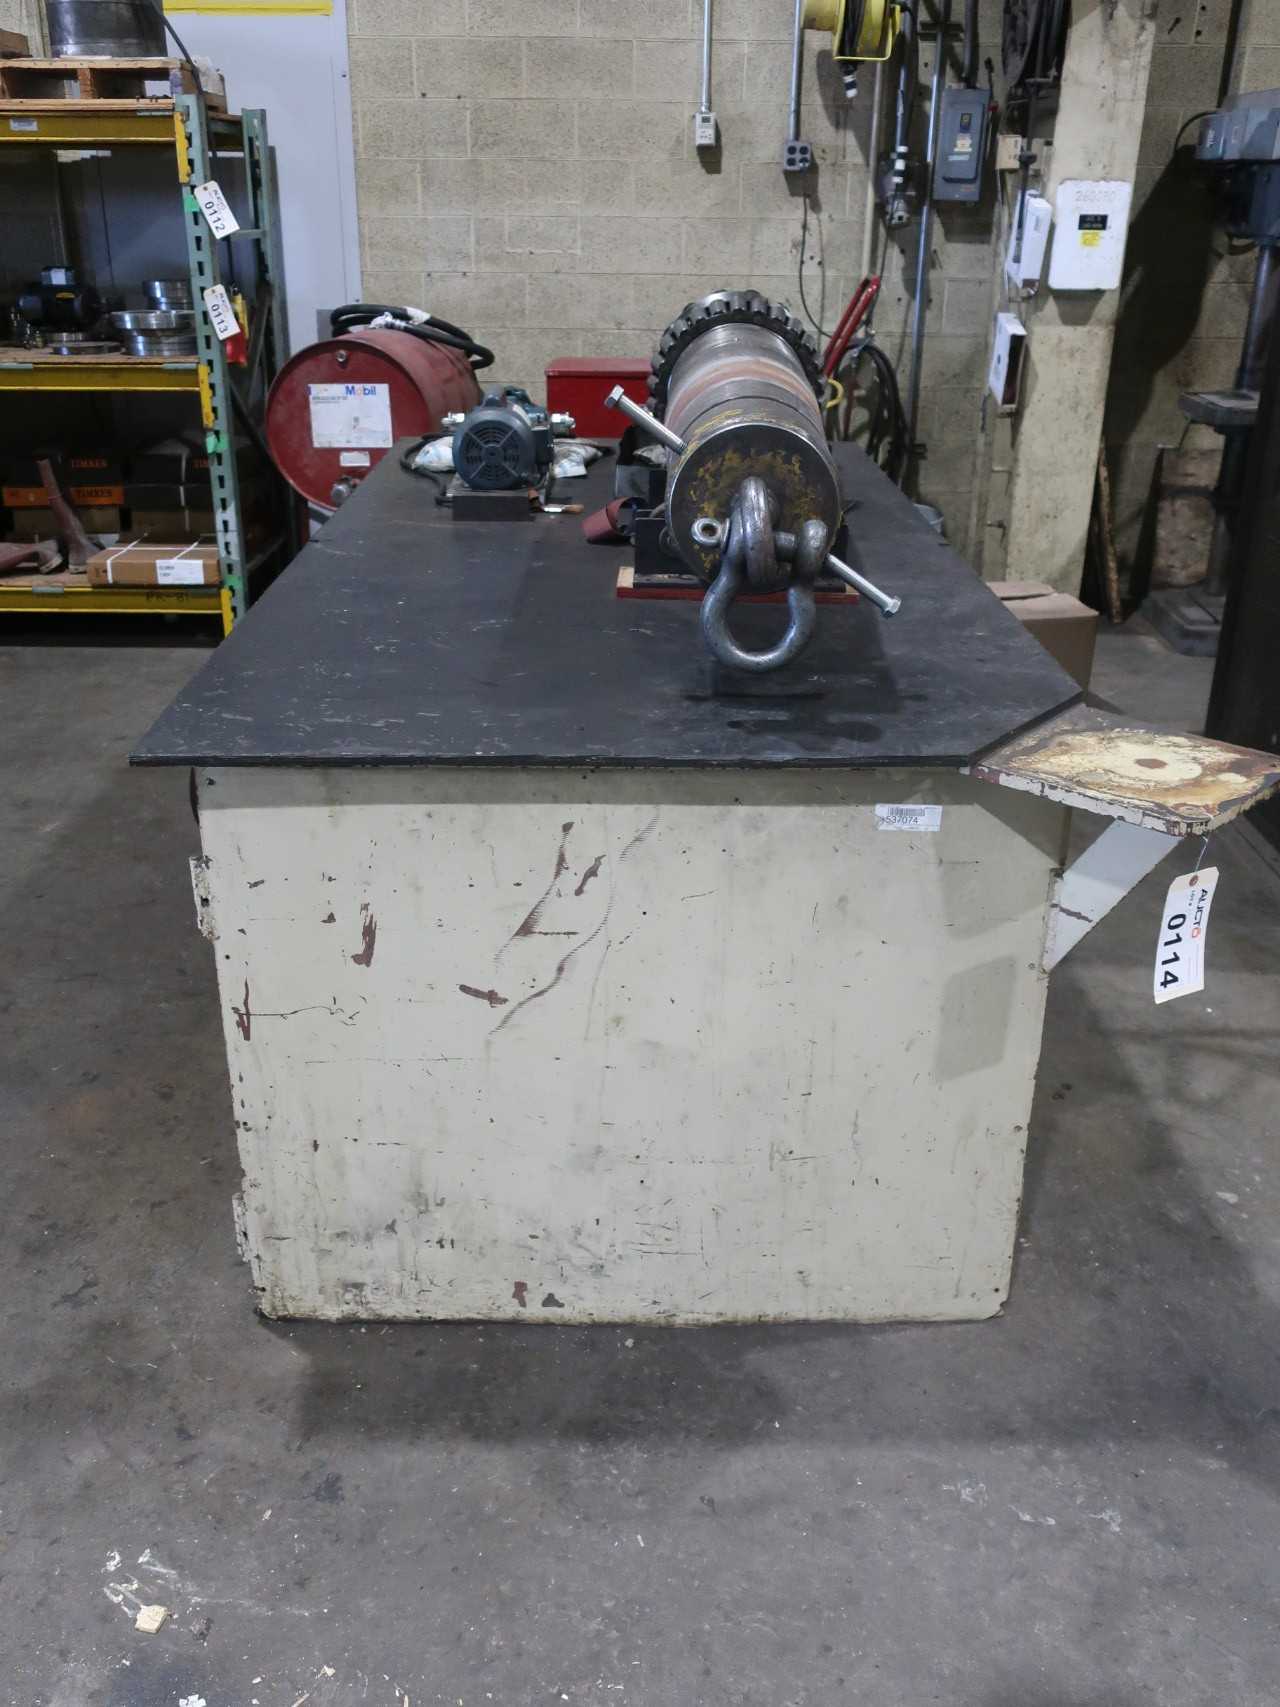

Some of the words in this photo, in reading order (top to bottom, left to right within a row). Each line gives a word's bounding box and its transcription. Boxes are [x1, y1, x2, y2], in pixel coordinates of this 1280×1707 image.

[204, 201, 226, 232] 0112
[211, 303, 229, 333] 0113
[345, 385, 377, 396] Mobil
[1192, 888, 1209, 938] AUCTO
[1160, 913, 1187, 989] 0114
